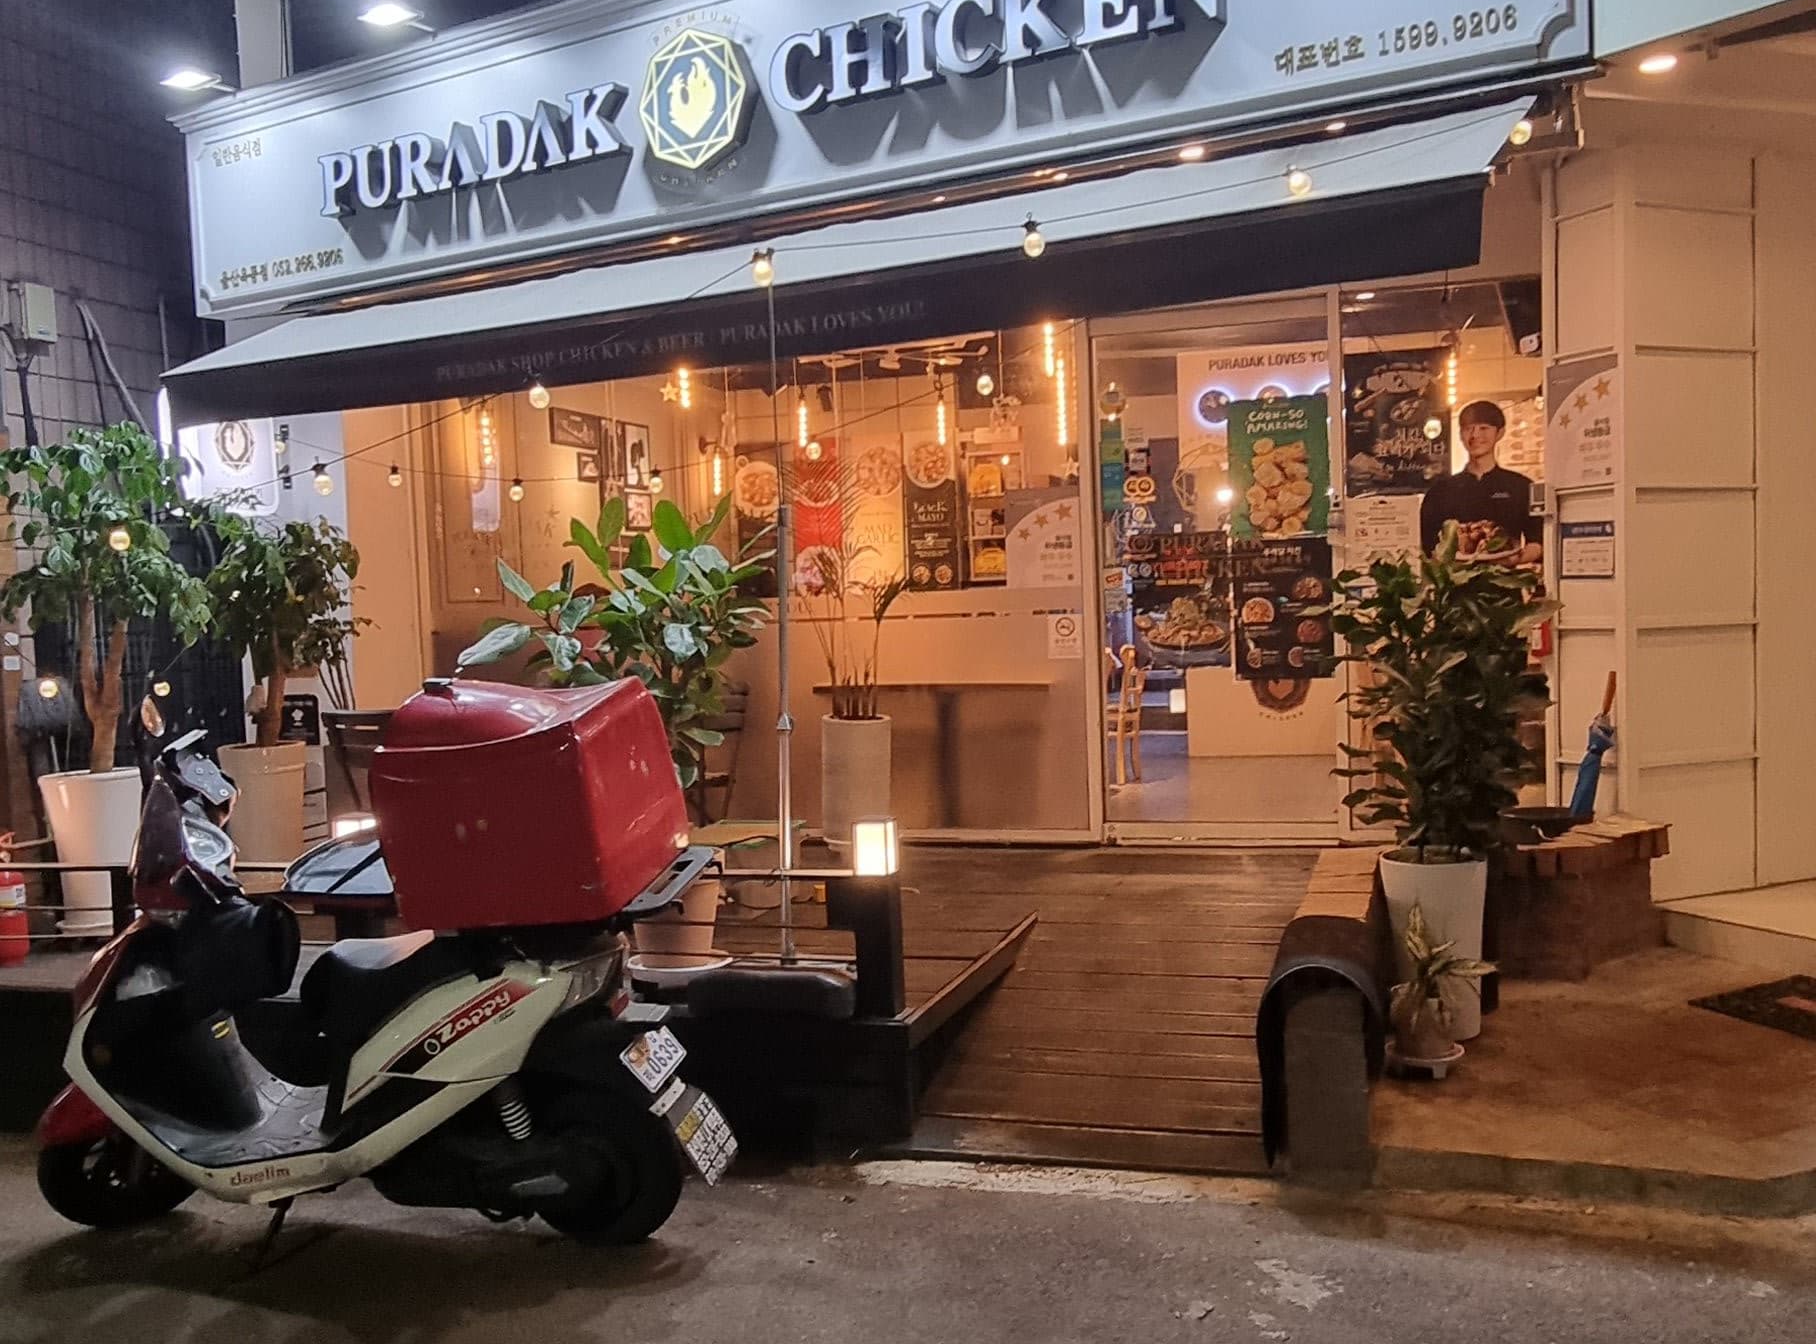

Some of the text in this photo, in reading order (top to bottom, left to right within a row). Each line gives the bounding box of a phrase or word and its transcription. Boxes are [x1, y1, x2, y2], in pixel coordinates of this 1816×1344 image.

[652, 10, 734, 47] PREMIUM
[1273, 3, 1518, 77] 대표번호 1599.9206
[211, 136, 263, 168] 일반음식점
[317, 81, 630, 217] PURADAK
[1208, 349, 1329, 372] PURADAK LOVES YO
[435, 990, 512, 1044] Zappy
[647, 1037, 681, 1075] 0639
